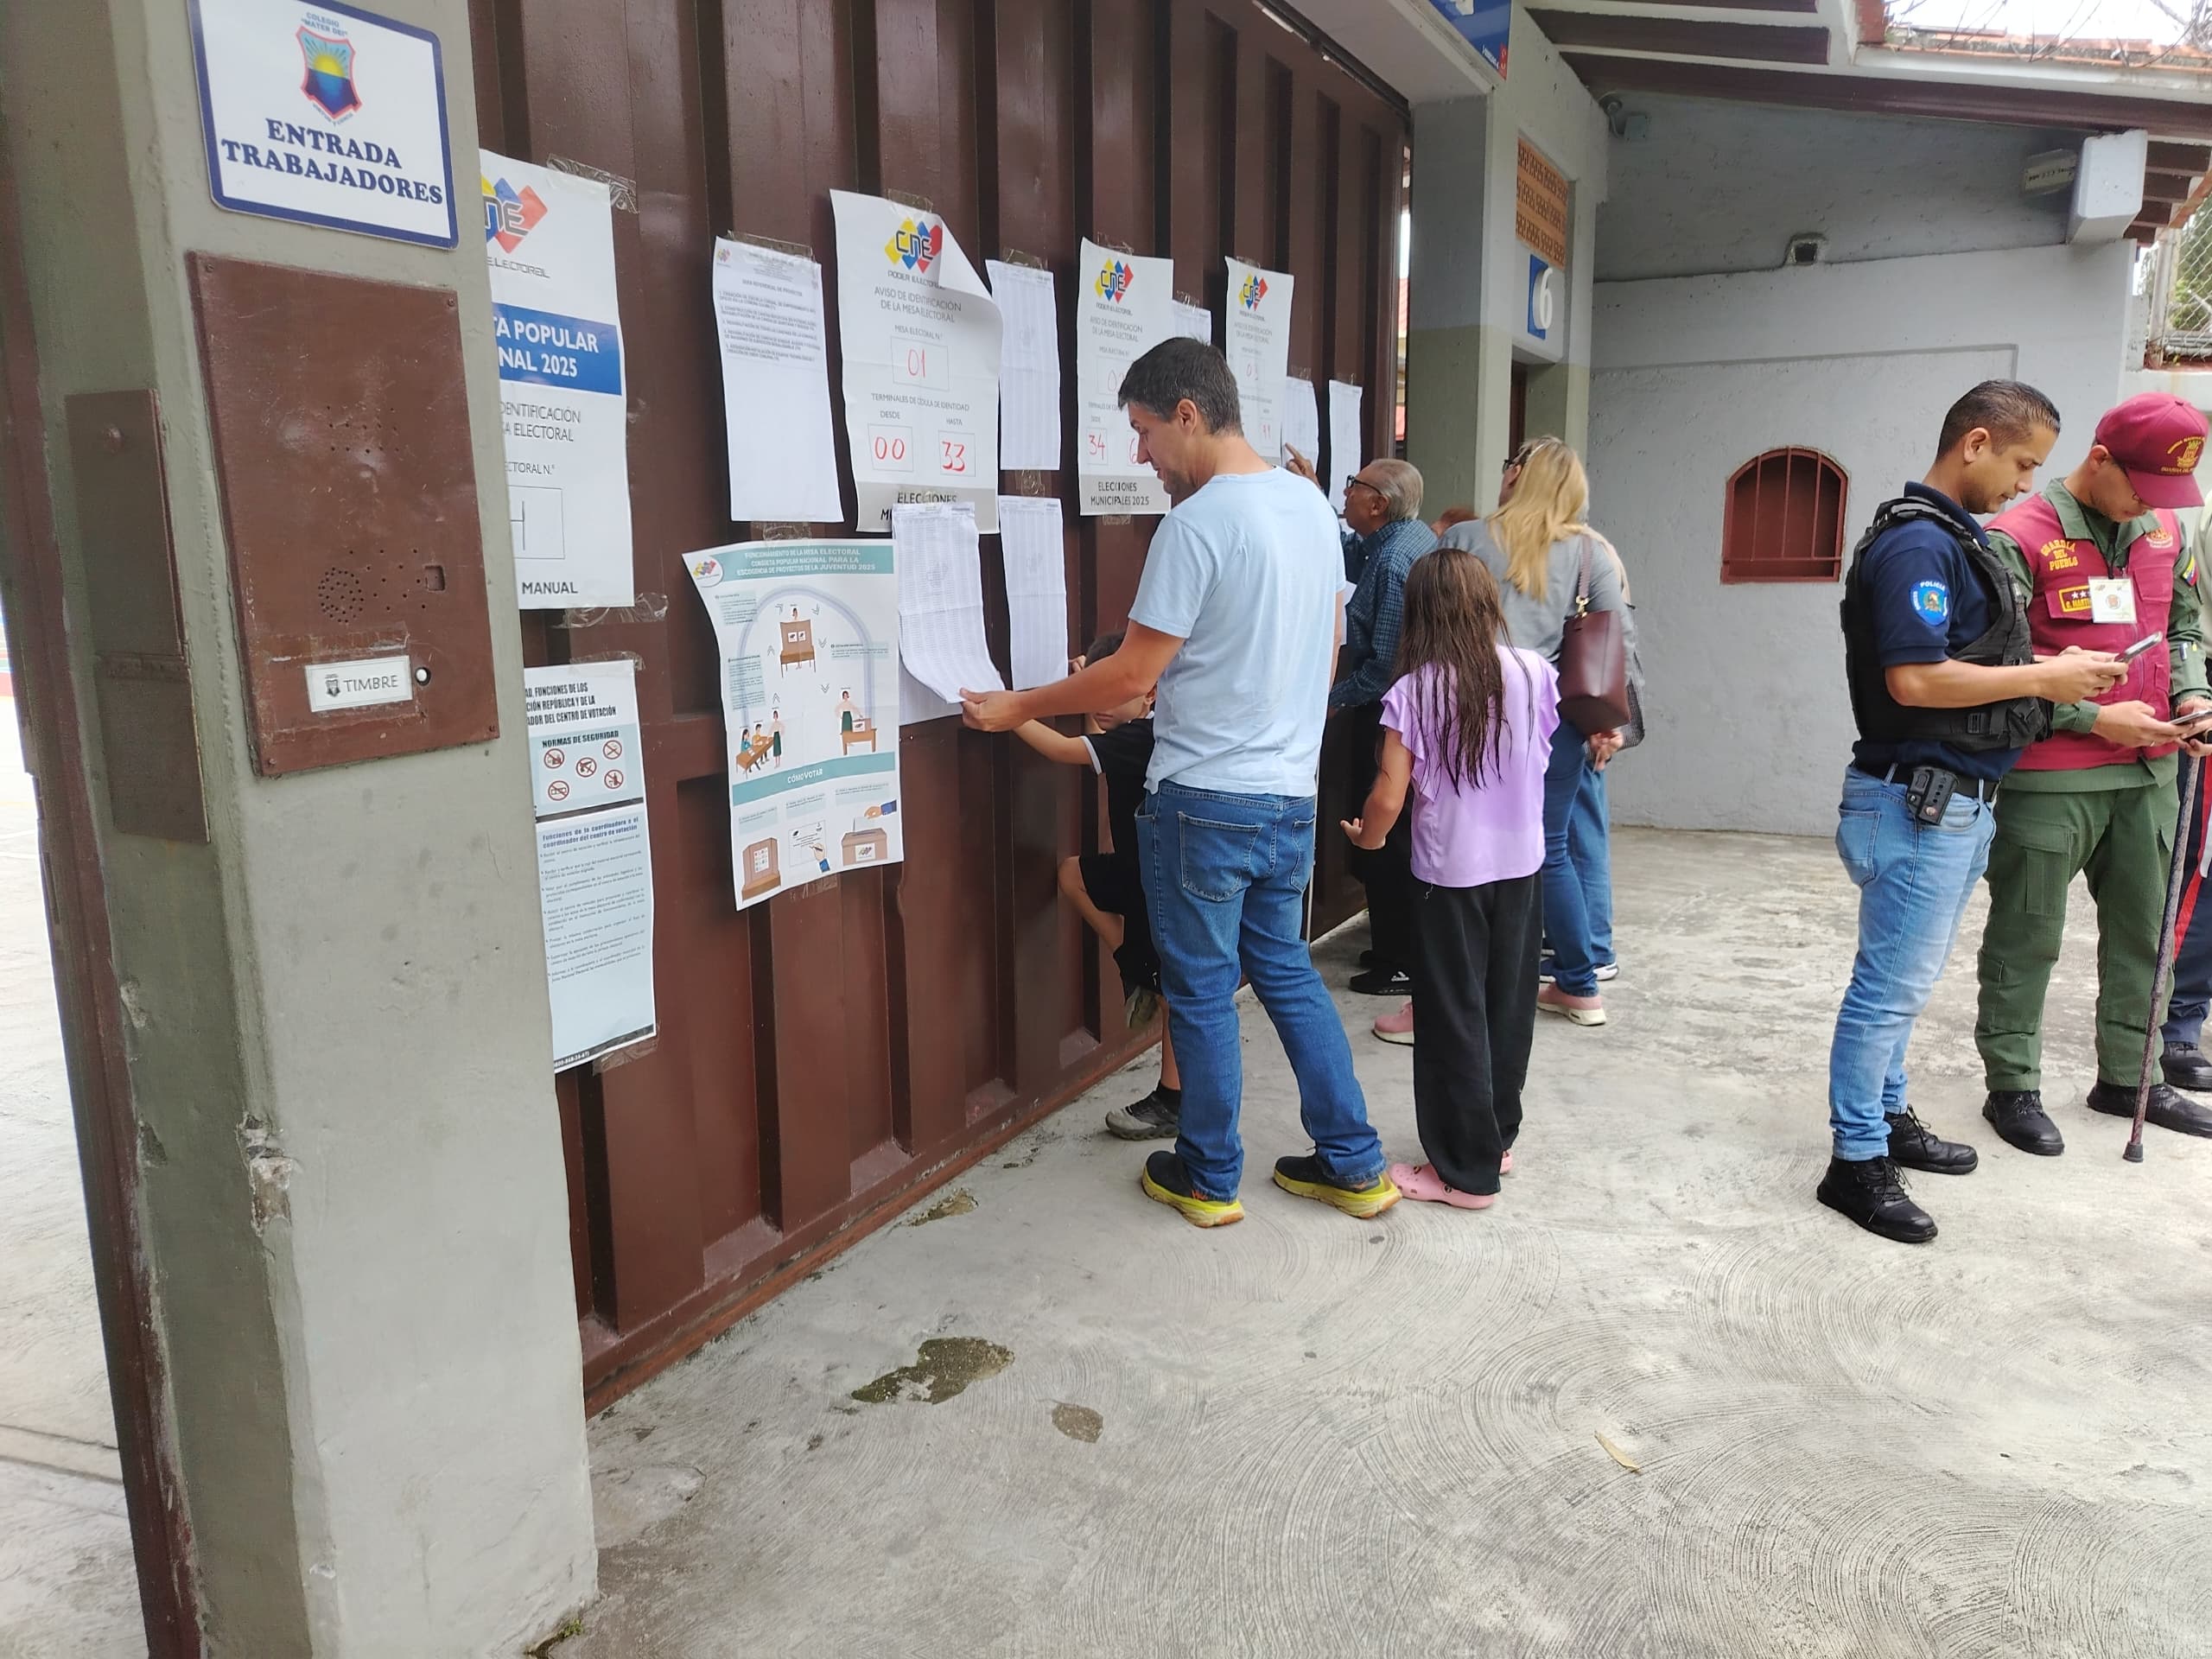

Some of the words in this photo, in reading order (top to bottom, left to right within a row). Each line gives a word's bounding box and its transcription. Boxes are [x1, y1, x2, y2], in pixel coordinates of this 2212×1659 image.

[306, 12, 340, 28] COLEGIO
[266, 118, 402, 168] ENTRADA
[221, 138, 443, 205] TRABAJADORES
[874, 286, 896, 298] AVISO
[898, 289, 906, 301] DE
[1533, 268, 1553, 330] 6
[881, 300, 892, 309] DE
[893, 302, 900, 311] LA
[903, 304, 920, 315] MESA
[921, 308, 955, 322] ELECTORAL
[514, 320, 600, 353] POPULAR
[542, 353, 577, 378] 2025
[907, 349, 925, 378] 01
[871, 393, 908, 403] TERMINALES
[941, 402, 969, 411] IDENTIDAD
[880, 410, 900, 419] DESDE
[514, 423, 574, 442] ELECTORAL
[874, 436, 905, 461] 00
[1089, 433, 1105, 461] 34
[942, 441, 965, 472] 33
[1098, 481, 1137, 492] ELECCIONES
[1090, 496, 1131, 505] MUNICIPALES
[1132, 496, 1149, 505] 2025
[2041, 539, 2076, 556] GUARDIA
[2053, 549, 2068, 560] DEL
[2049, 556, 2079, 571] PUEBLO
[522, 582, 578, 594] MANUAL
[343, 675, 398, 692] TIMBRE
[535, 684, 568, 697] FUNCIONES
[569, 683, 576, 693] DE
[576, 682, 588, 692] LOS
[575, 696, 579, 706] Y
[581, 696, 588, 705] DE
[588, 695, 595, 705] LA
[544, 713, 556, 724] DEL
[556, 710, 579, 722] CENTRO
[581, 709, 588, 719] DE
[588, 705, 616, 718] VOTACIÓN
[542, 736, 571, 747] NORMAS
[573, 735, 581, 744] DE
[582, 730, 619, 742] SEGURIDAD
[804, 768, 823, 779] VOTAR
